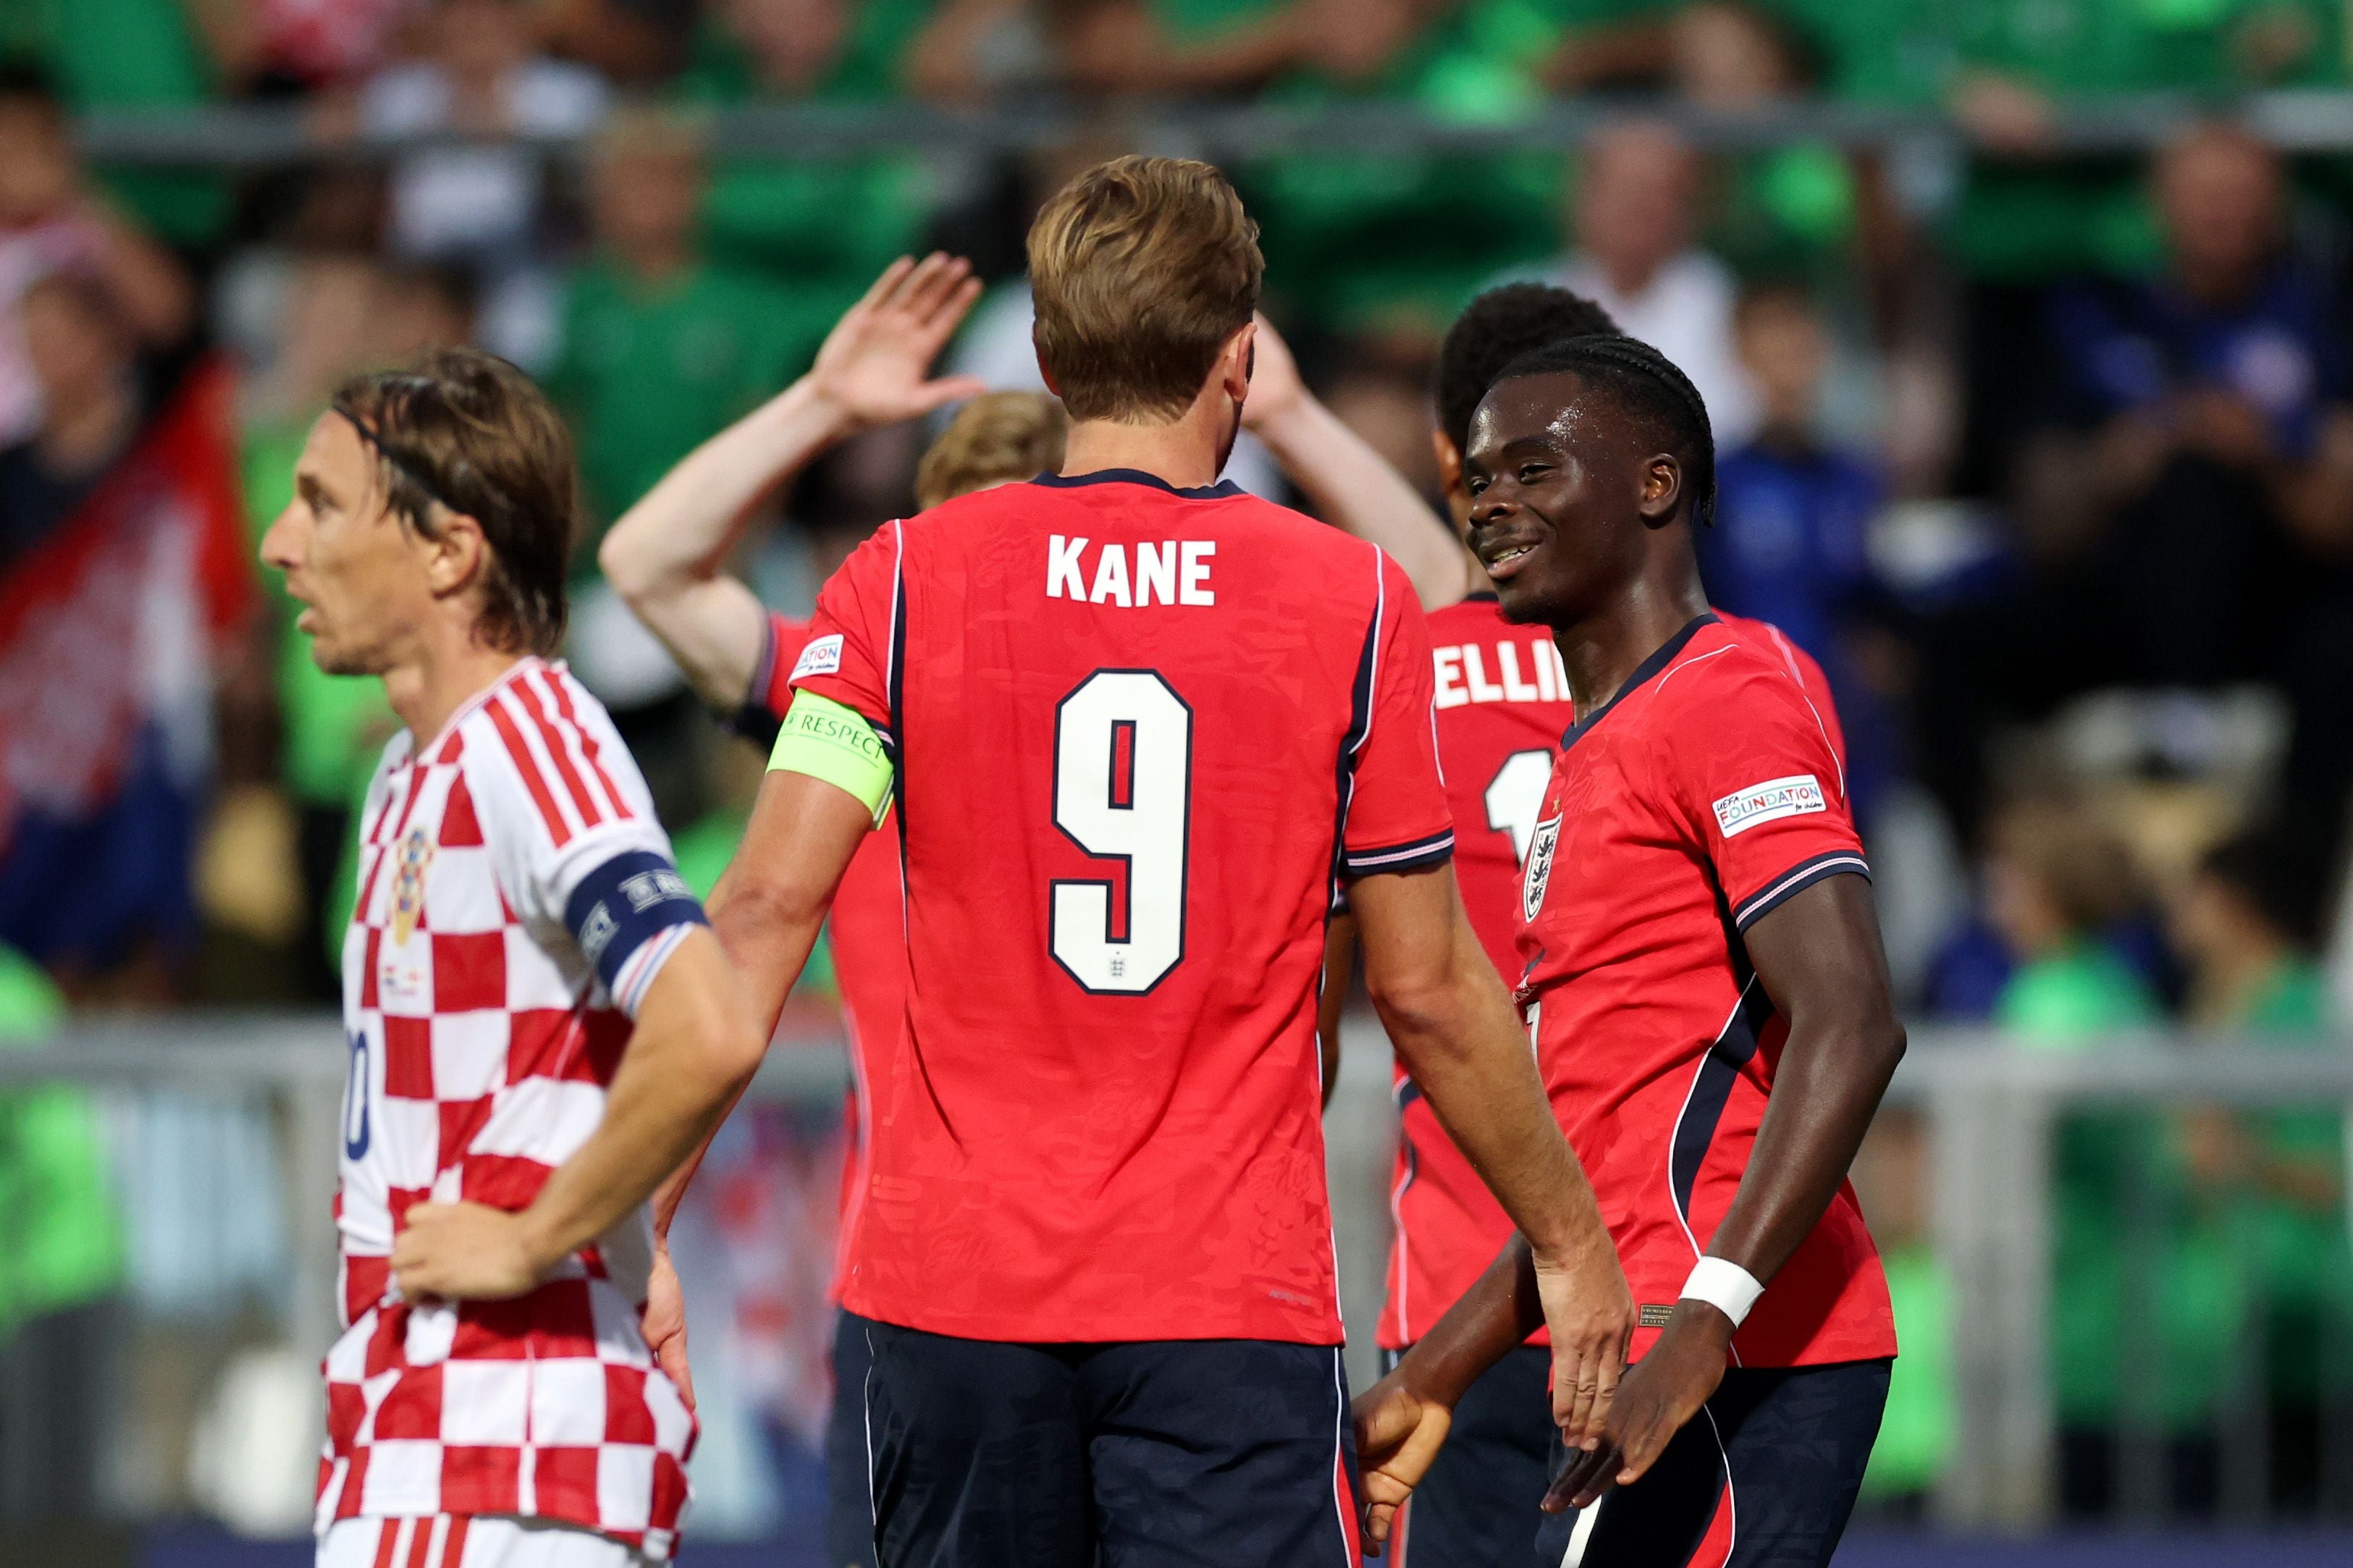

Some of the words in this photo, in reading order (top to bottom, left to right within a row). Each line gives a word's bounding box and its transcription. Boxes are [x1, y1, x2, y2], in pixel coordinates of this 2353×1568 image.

[1045, 534, 1216, 608] KANE
[802, 646, 838, 662] ATION
[1432, 638, 1572, 709] ELLI
[801, 714, 883, 759] RESPECT
[1717, 795, 1740, 812] UEFA
[1720, 787, 1820, 824] FOUNDATION
[1048, 667, 1194, 996] 9
